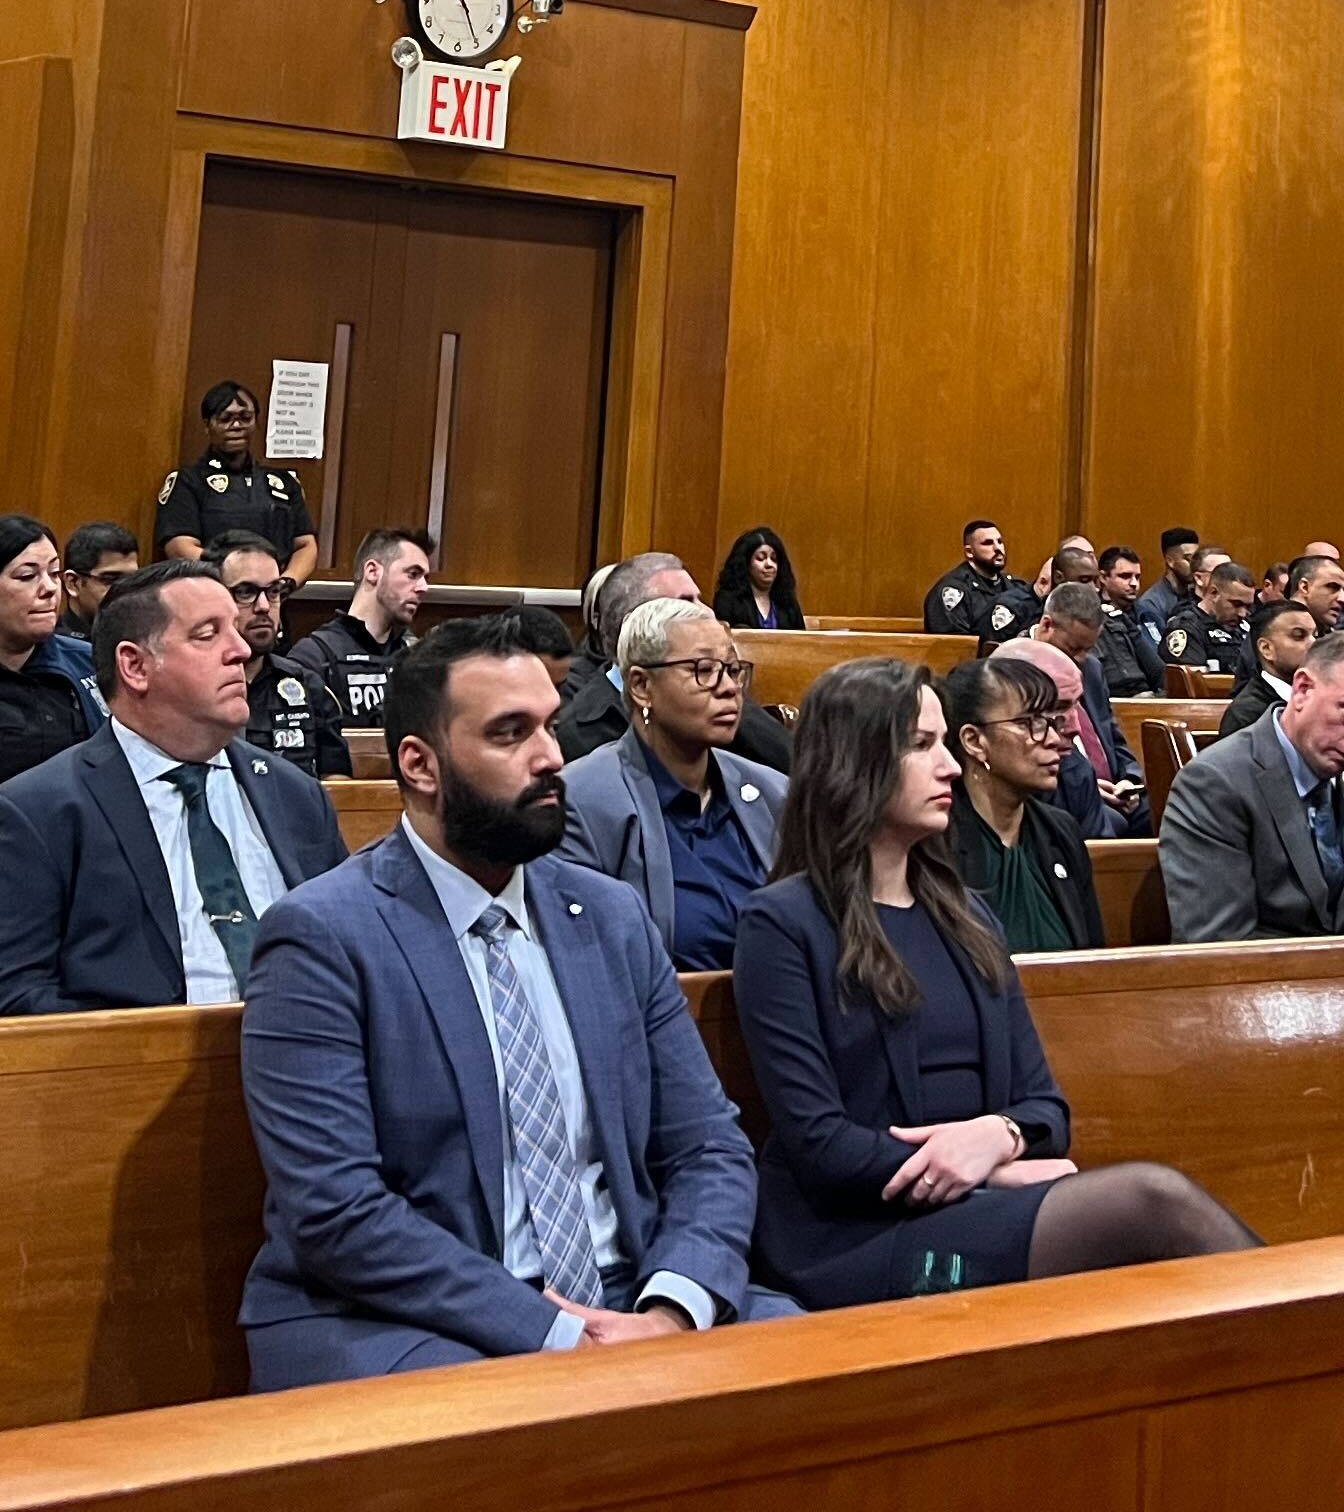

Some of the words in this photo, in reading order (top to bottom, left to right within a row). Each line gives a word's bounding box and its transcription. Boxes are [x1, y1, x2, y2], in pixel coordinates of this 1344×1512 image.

[494, 4, 501, 17] 3
[424, 15, 433, 29] 8
[486, 23, 494, 35] 4
[438, 33, 445, 45] 7
[473, 37, 480, 50] 5
[453, 41, 462, 53] 6
[428, 75, 502, 141] EXIT
